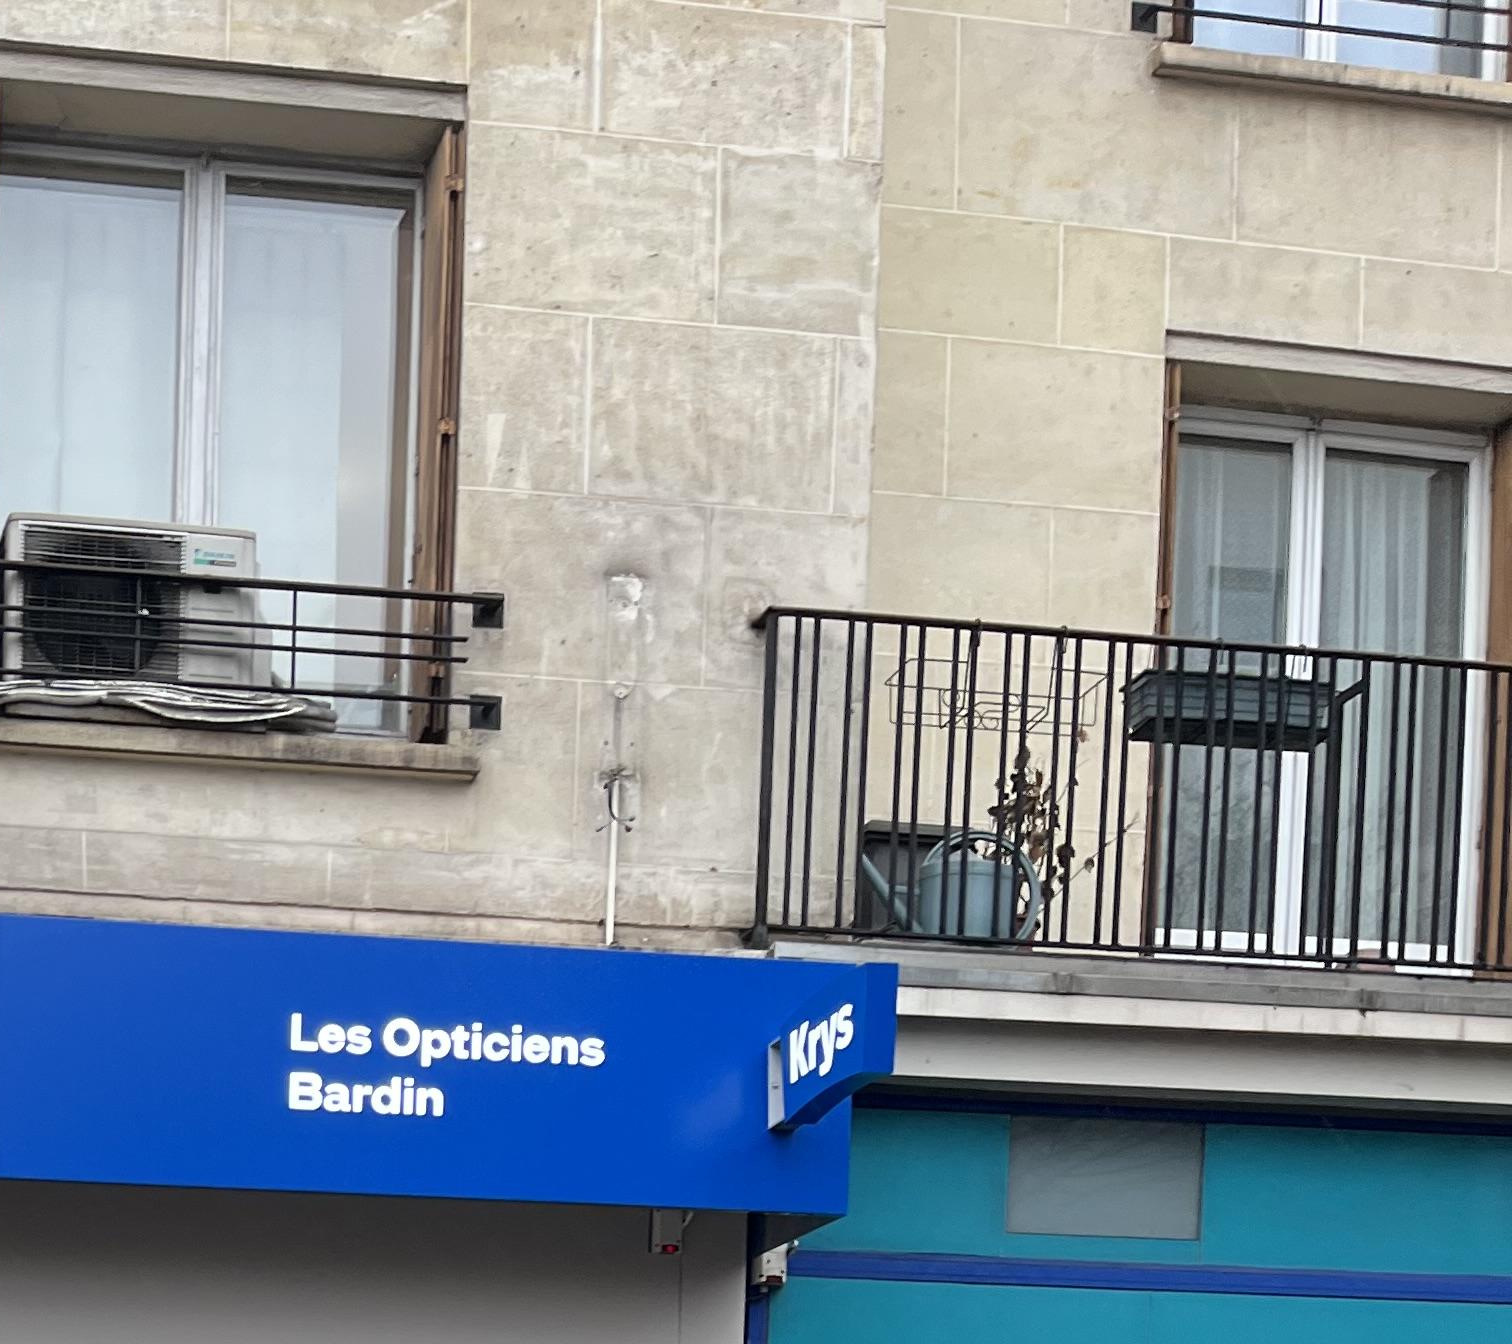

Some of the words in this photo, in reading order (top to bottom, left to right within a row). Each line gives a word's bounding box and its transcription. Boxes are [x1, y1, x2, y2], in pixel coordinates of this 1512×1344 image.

[290, 1012, 372, 1055] Les
[382, 1017, 606, 1068] Opticiens
[788, 1002, 855, 1084] Krys
[288, 1072, 445, 1118] Bardin
